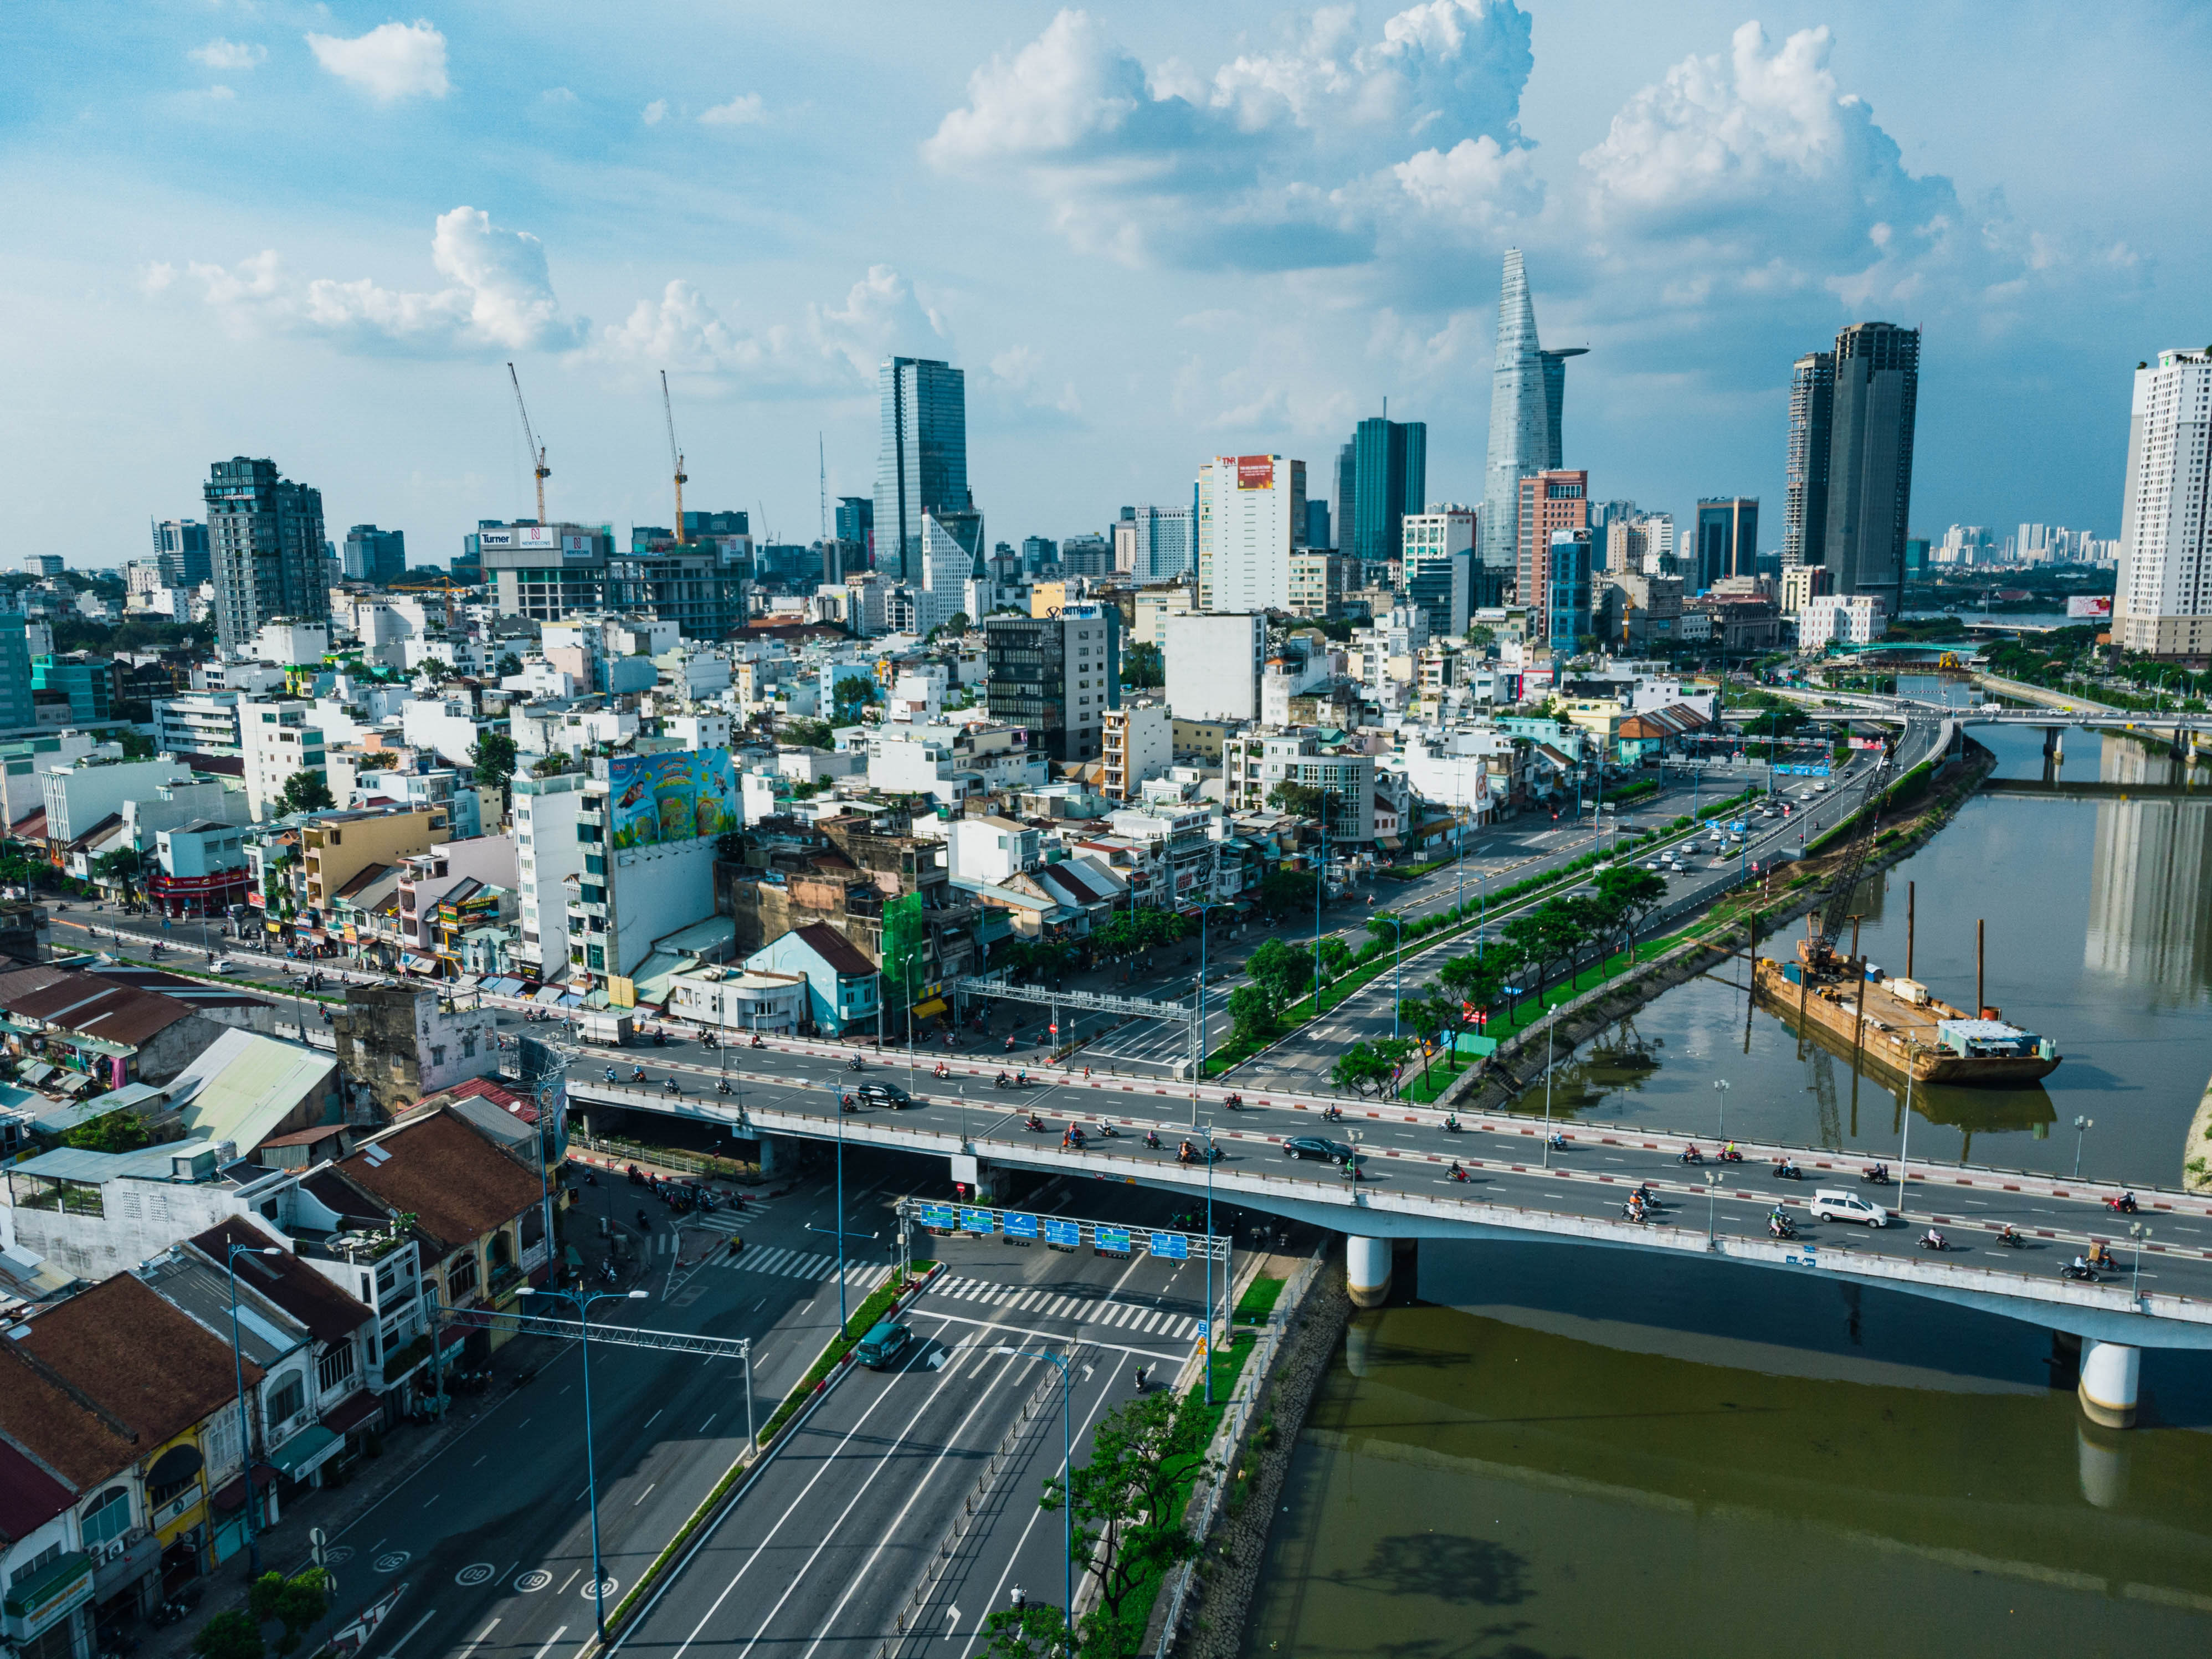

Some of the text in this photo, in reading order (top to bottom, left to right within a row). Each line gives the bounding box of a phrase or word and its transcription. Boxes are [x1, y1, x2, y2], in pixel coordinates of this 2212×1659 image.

[1222, 457, 1236, 465] TNR
[482, 534, 509, 543] Turner
[379, 1555, 403, 1567] 50
[463, 1568, 486, 1580] 60
[521, 1575, 545, 1586] 60
